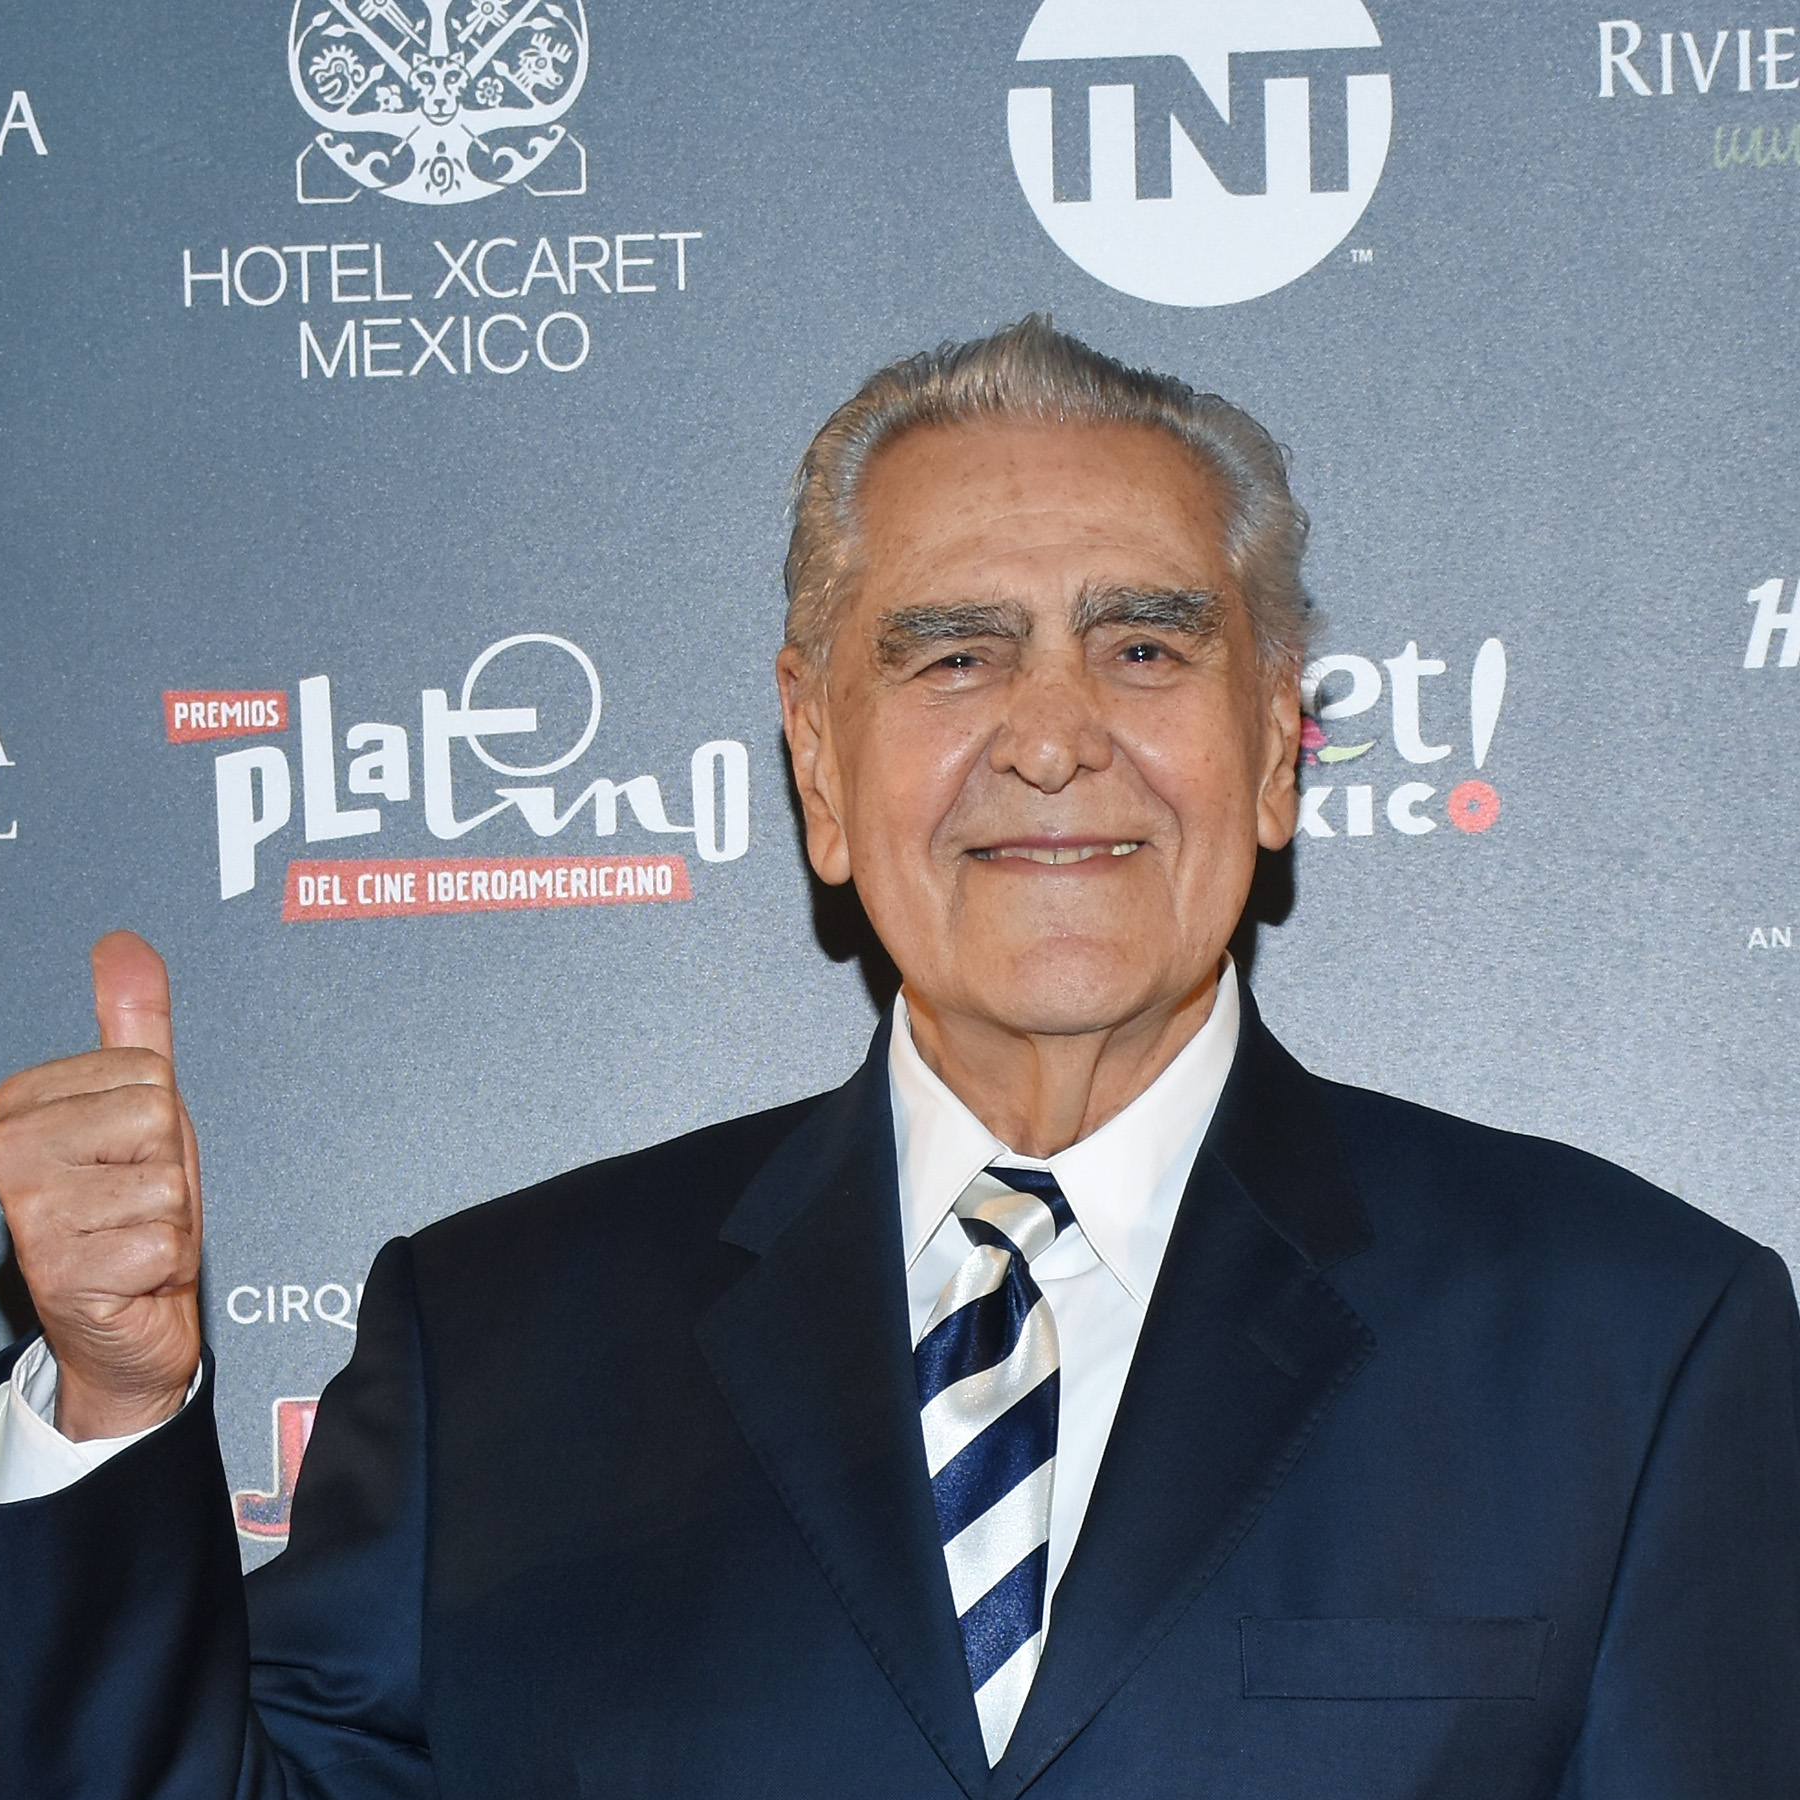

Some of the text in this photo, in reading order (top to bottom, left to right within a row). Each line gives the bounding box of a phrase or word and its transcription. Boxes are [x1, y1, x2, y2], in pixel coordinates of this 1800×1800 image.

[1008, 47, 1391, 204] TNT
[183, 231, 703, 307] HOTEL XCARET
[300, 311, 590, 378] MEXICO
[175, 700, 279, 728] PREMIOS
[299, 865, 672, 905] DEL CINE IBEROAMERICANO
[1748, 927, 1792, 949] AN
[226, 1283, 363, 1331] CIRQ
